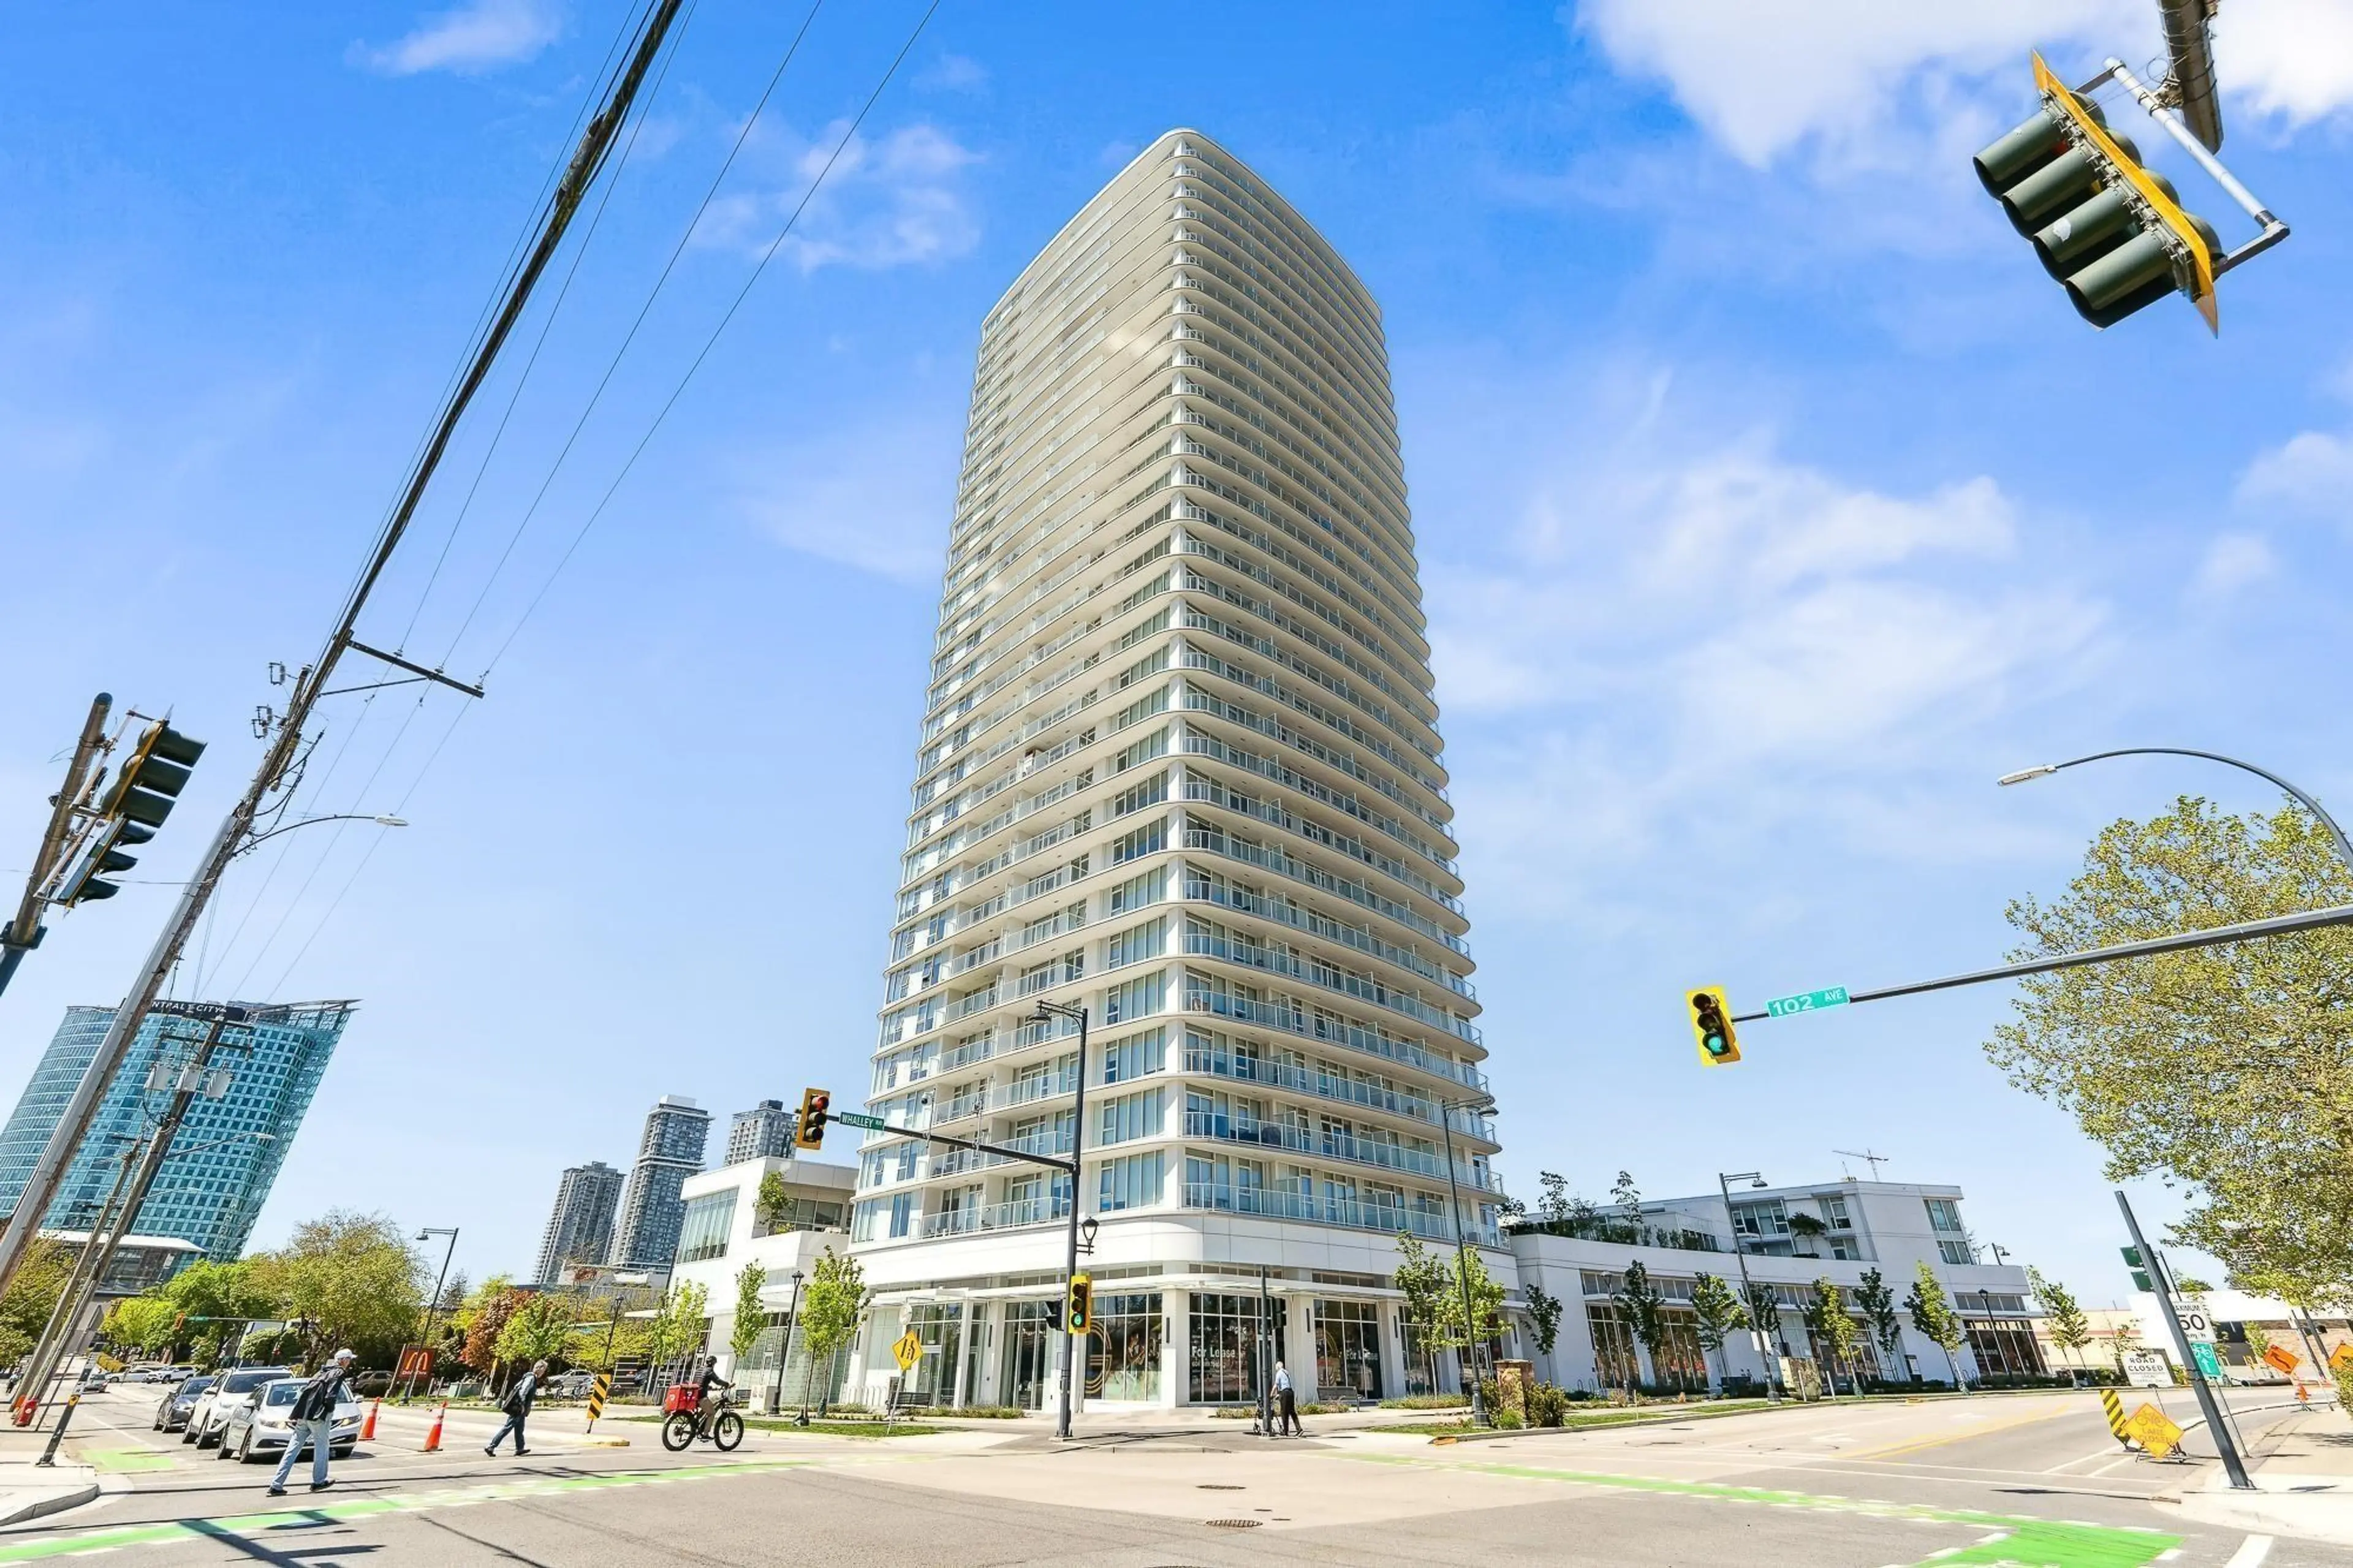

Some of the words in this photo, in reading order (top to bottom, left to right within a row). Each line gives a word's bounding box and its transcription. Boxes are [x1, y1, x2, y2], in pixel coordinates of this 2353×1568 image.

[1773, 996, 1815, 1015] 102
[1825, 990, 1843, 1001] AVE
[843, 1114, 874, 1127] WHALLEY
[2177, 1314, 2205, 1330] 50
[1191, 1346, 1207, 1357] For
[1210, 1346, 1235, 1358] Lease
